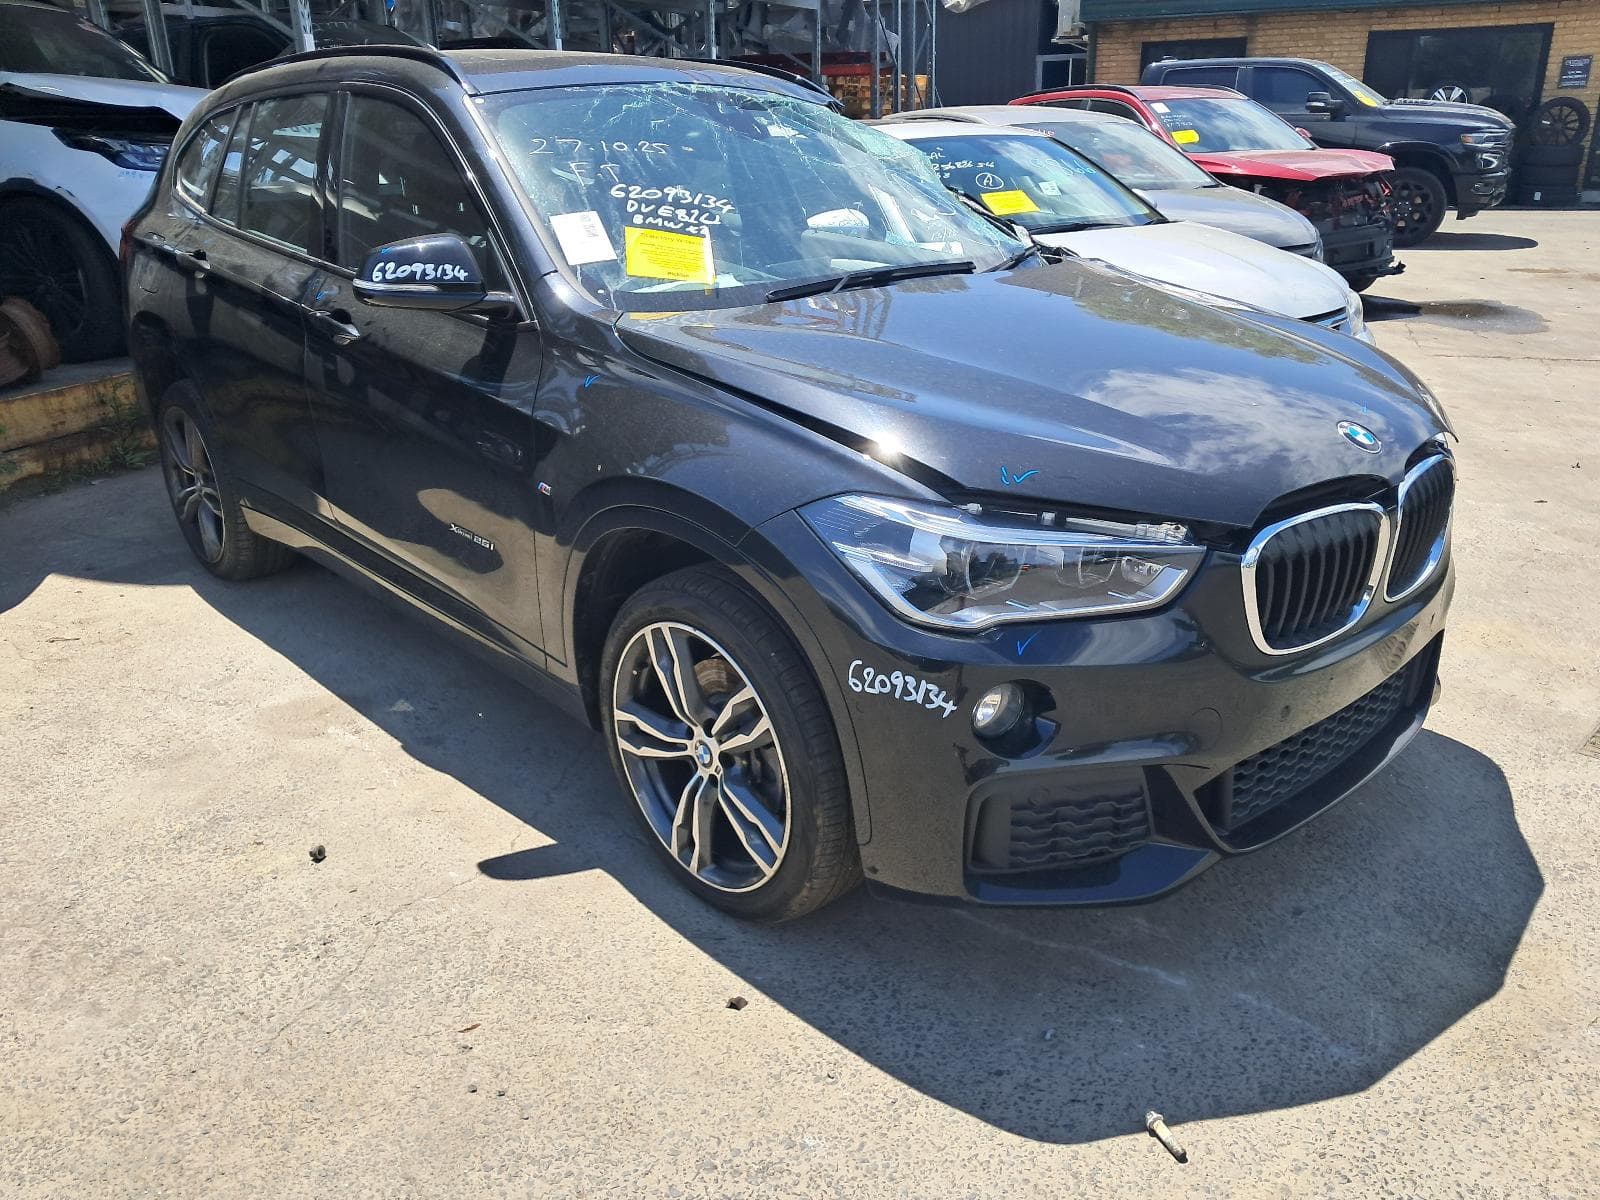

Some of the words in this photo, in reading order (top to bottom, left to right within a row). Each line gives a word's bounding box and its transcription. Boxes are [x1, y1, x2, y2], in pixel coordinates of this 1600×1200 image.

[610, 183, 736, 214] 62093134
[632, 214, 684, 229] BMW
[372, 262, 469, 282] 62093134
[848, 659, 958, 719] 62093134
